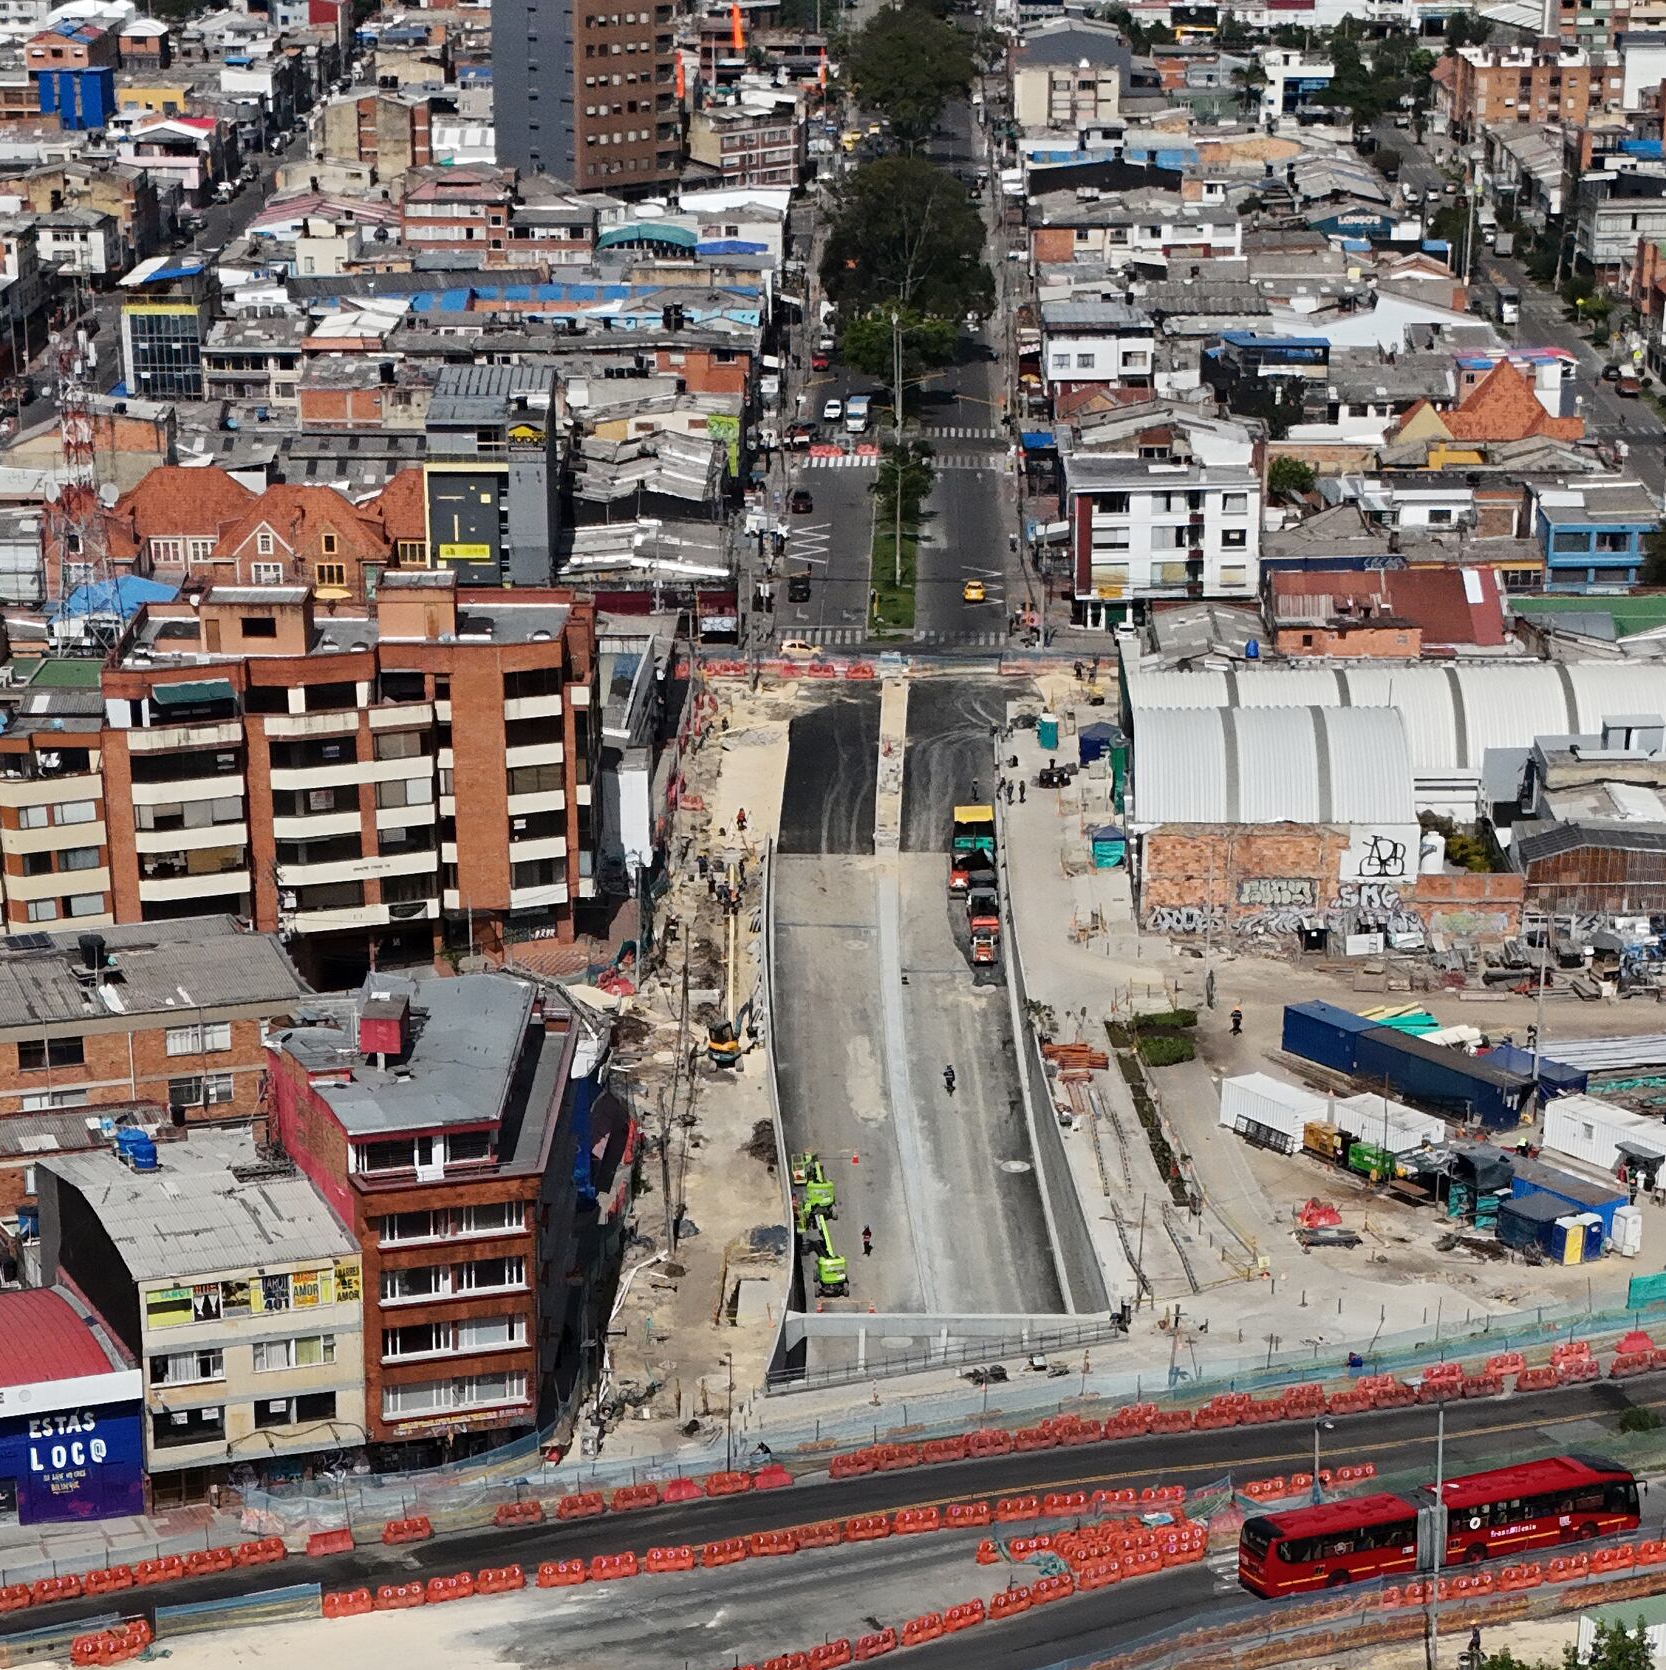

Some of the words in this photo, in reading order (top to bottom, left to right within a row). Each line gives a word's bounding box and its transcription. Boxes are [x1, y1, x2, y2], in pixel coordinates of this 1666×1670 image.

[293, 1283, 318, 1297] AMOR
[337, 1290, 360, 1302] AMOR
[30, 1438, 107, 1472] LOC@
